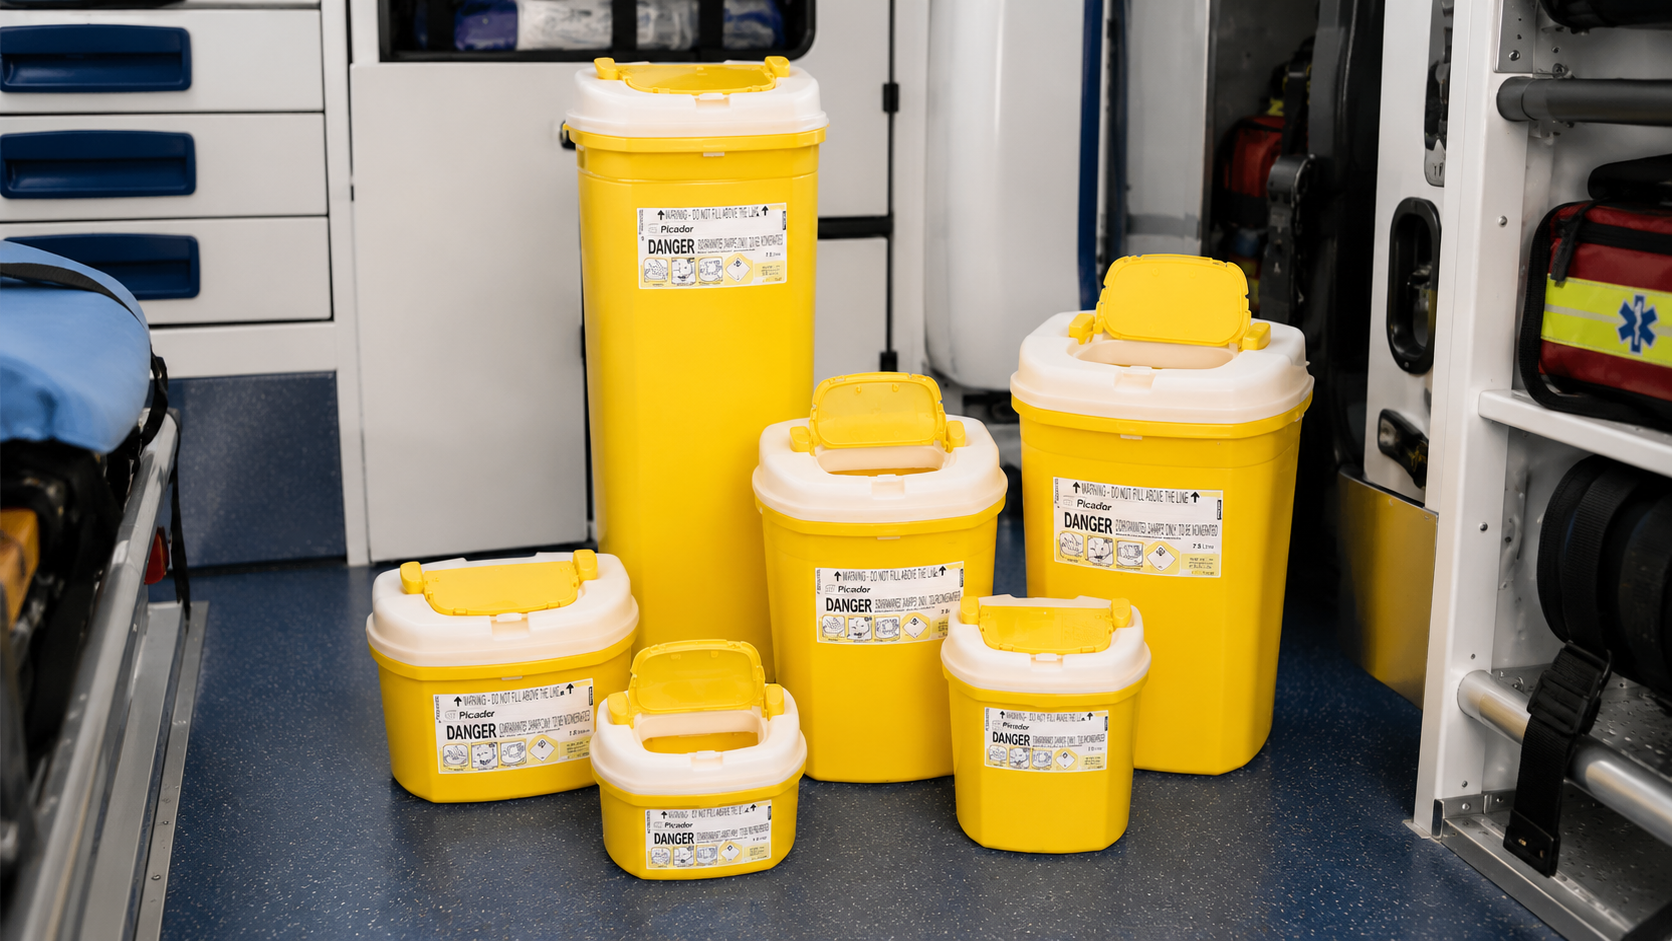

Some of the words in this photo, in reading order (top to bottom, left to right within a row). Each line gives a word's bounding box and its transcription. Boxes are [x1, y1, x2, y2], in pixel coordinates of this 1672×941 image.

[661, 225, 694, 234] Picador
[649, 239, 695, 254] DANGER
[1077, 499, 1112, 511] Picador
[1065, 512, 1112, 534] DANGER
[838, 585, 871, 593] Picador
[826, 598, 872, 613] DANGER
[447, 723, 496, 740] DANGER
[992, 732, 1030, 746] DANGER
[654, 832, 694, 844] DANGER
